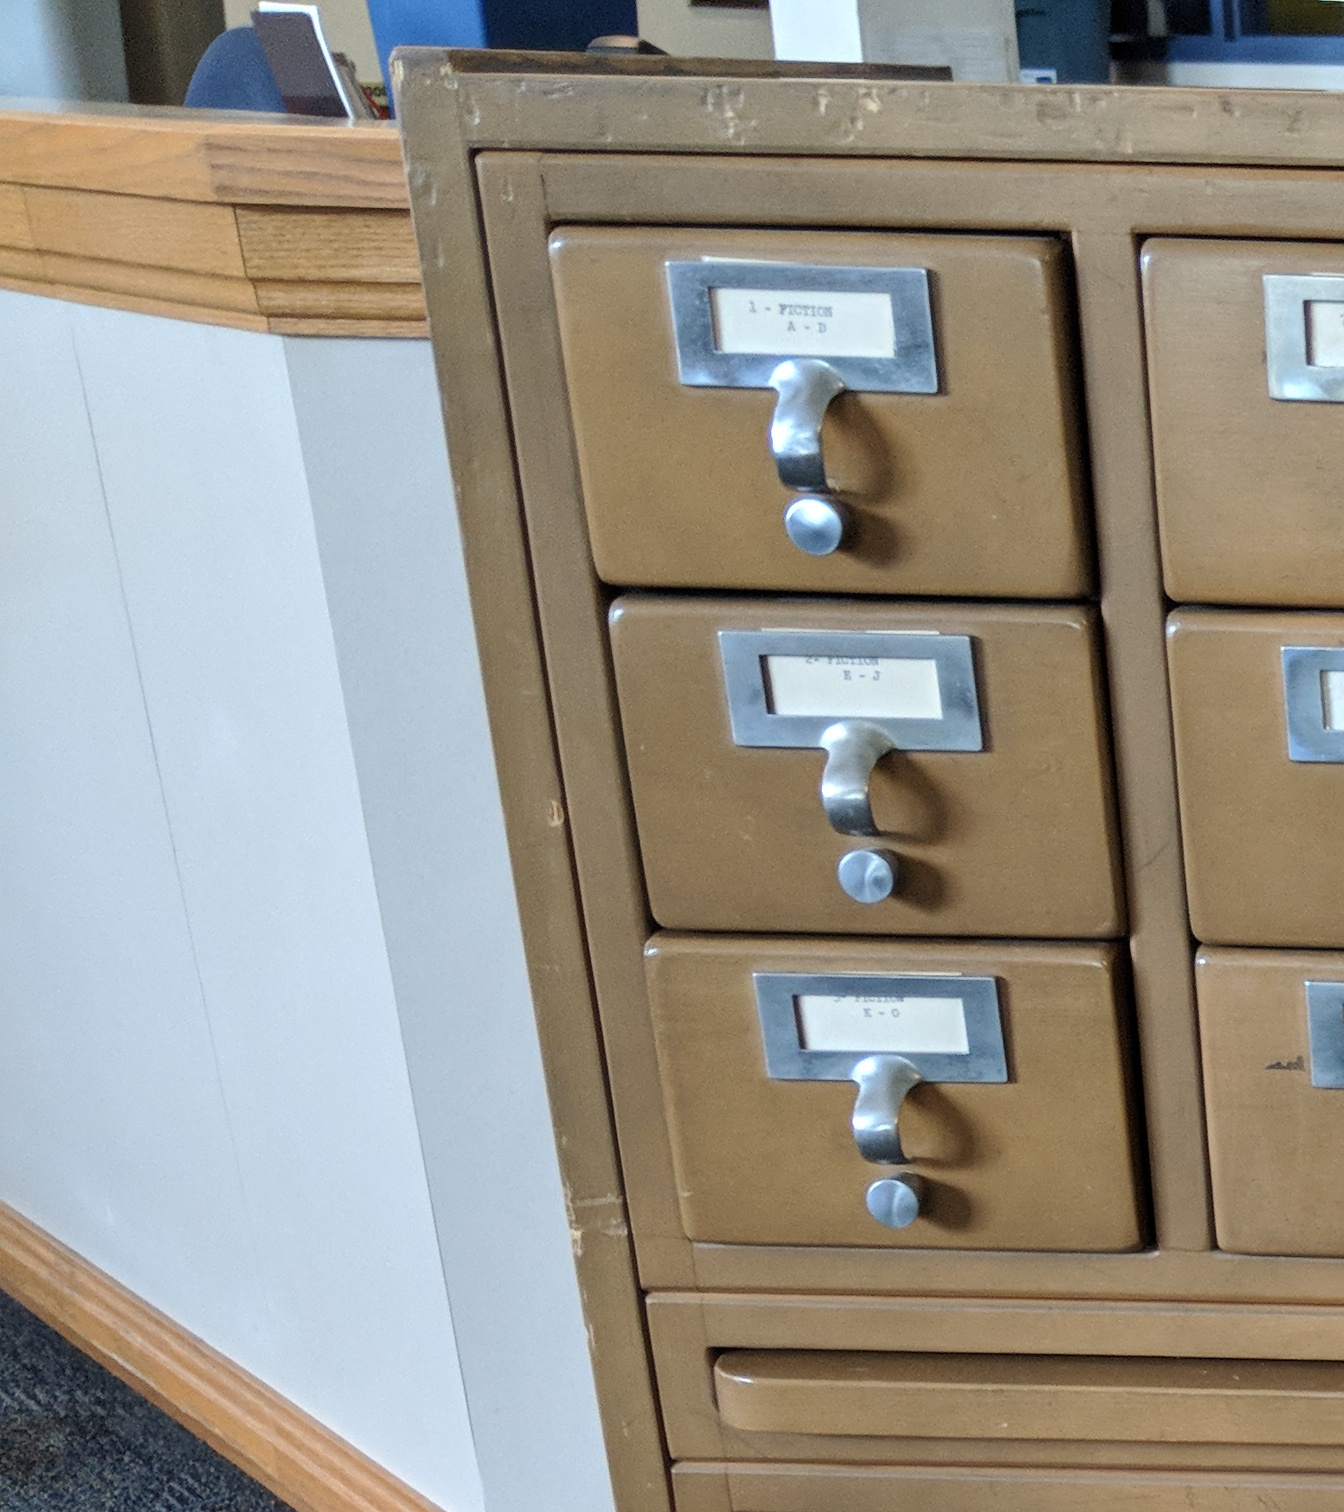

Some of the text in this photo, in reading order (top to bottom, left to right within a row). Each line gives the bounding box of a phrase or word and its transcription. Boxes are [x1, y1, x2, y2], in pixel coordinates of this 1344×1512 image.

[749, 301, 756, 313] 1
[779, 303, 833, 317] FICTION
[787, 321, 796, 332] A
[818, 322, 827, 333] D
[843, 670, 852, 680] E
[873, 671, 880, 681] J
